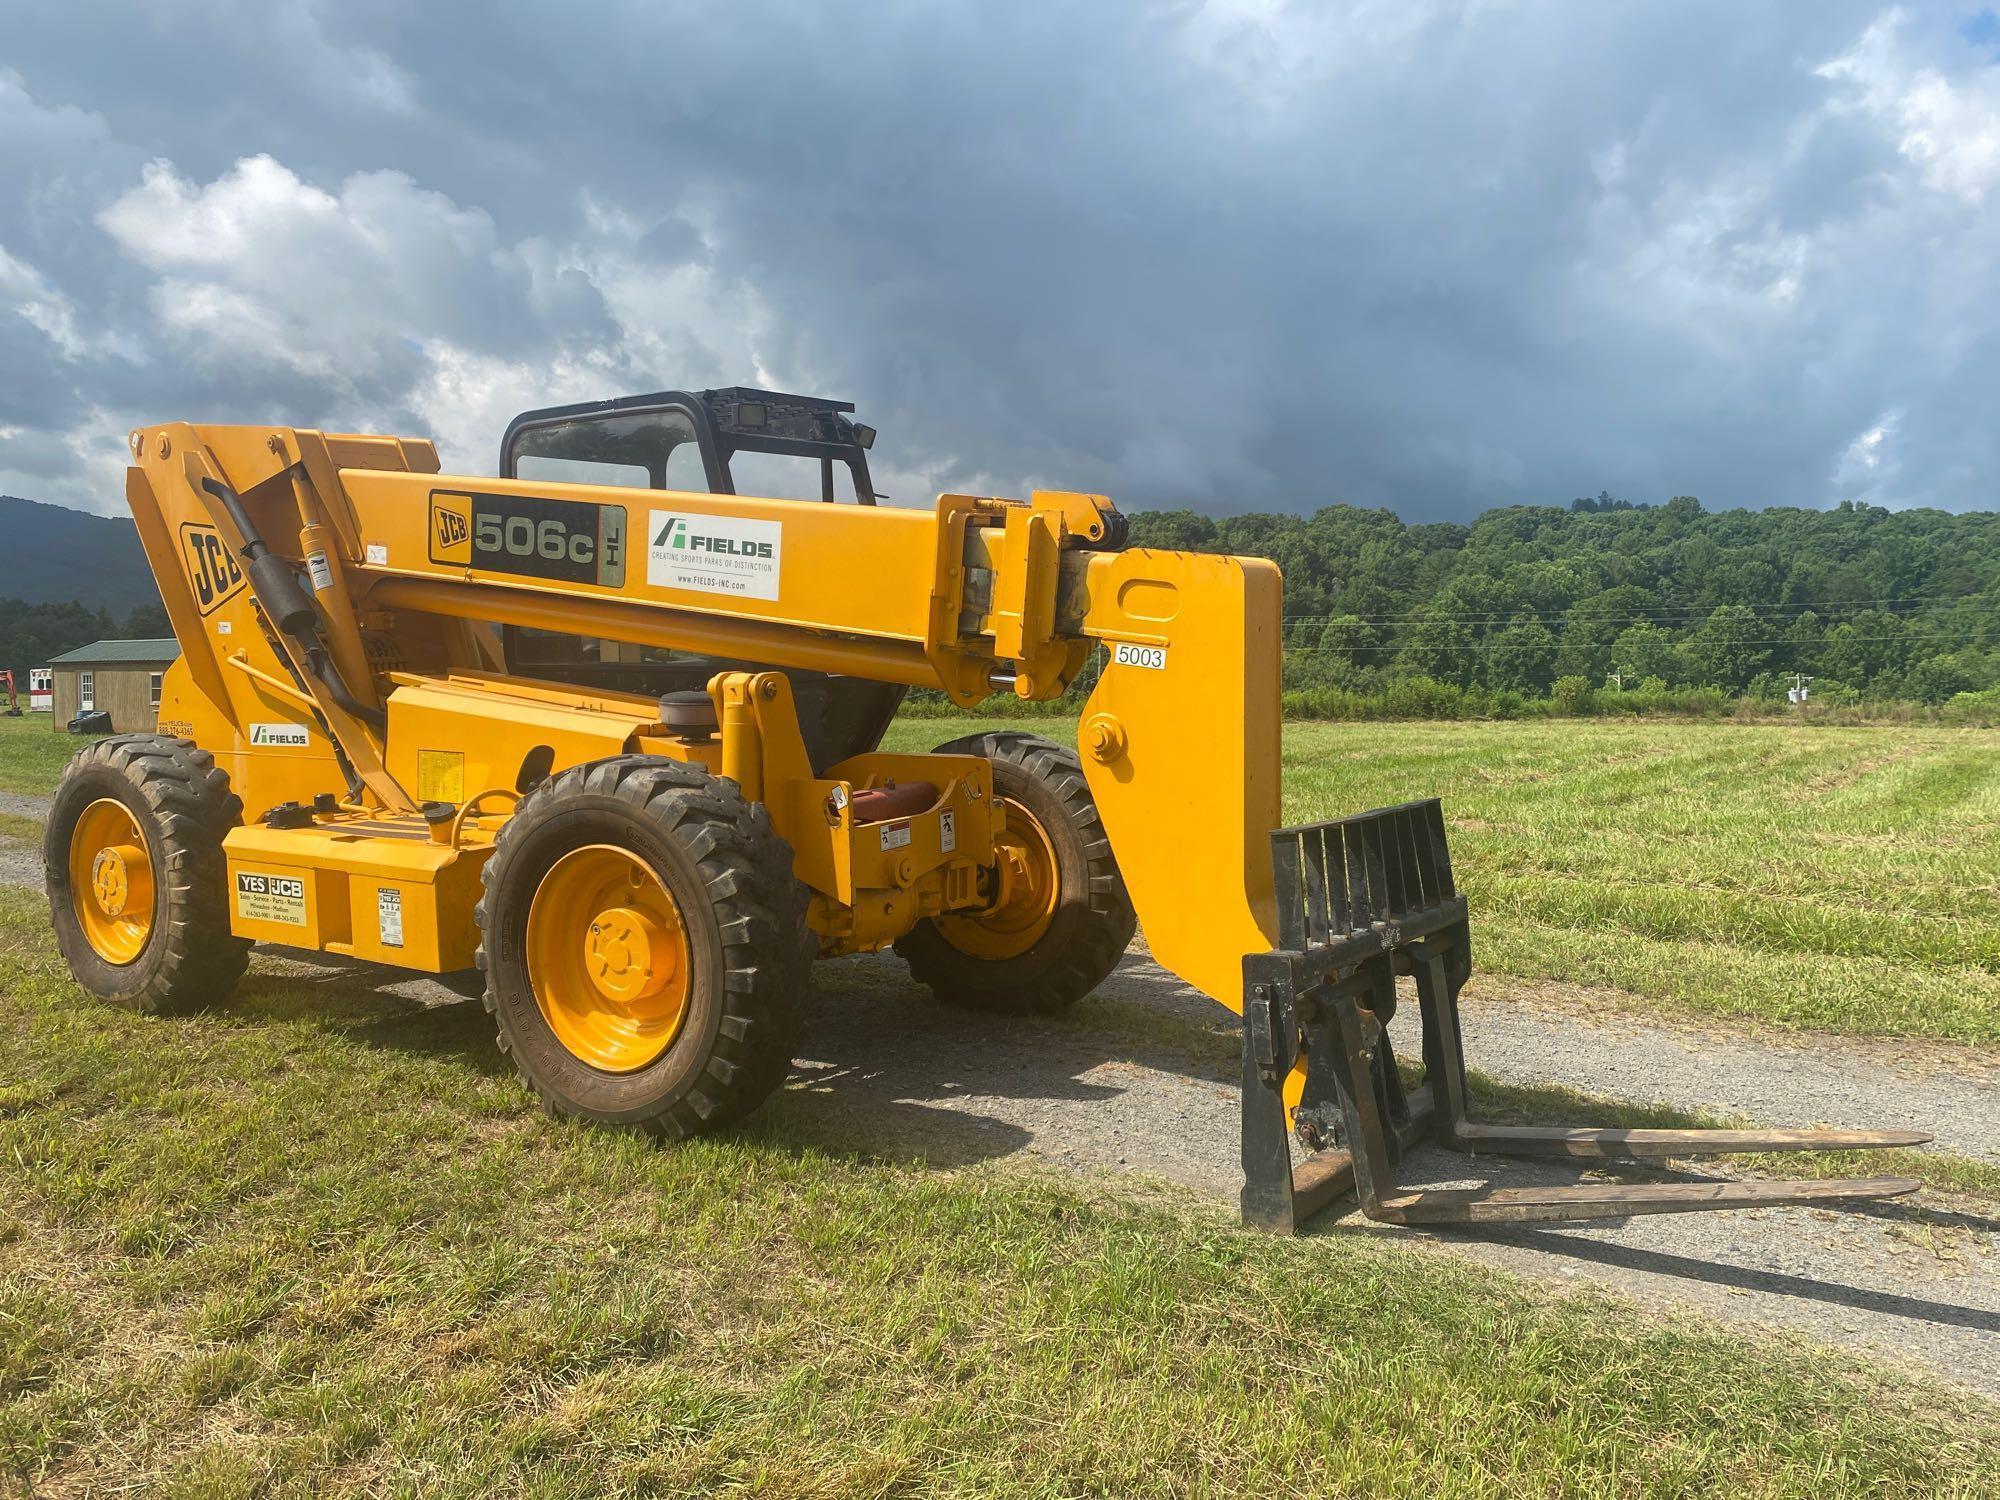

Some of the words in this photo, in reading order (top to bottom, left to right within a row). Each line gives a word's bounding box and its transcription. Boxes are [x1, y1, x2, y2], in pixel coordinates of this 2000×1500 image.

[440, 511, 466, 544] JCB
[690, 535, 773, 559] FIELDS
[652, 551, 679, 562] CREATING
[680, 553, 702, 565] SPORTS
[724, 559, 732, 568] OF
[734, 560, 772, 573] DISTINCTION
[1118, 646, 1162, 668] 5003
[269, 735, 306, 744] FIELDS
[241, 876, 265, 893] YES
[271, 879, 303, 898] JCB
